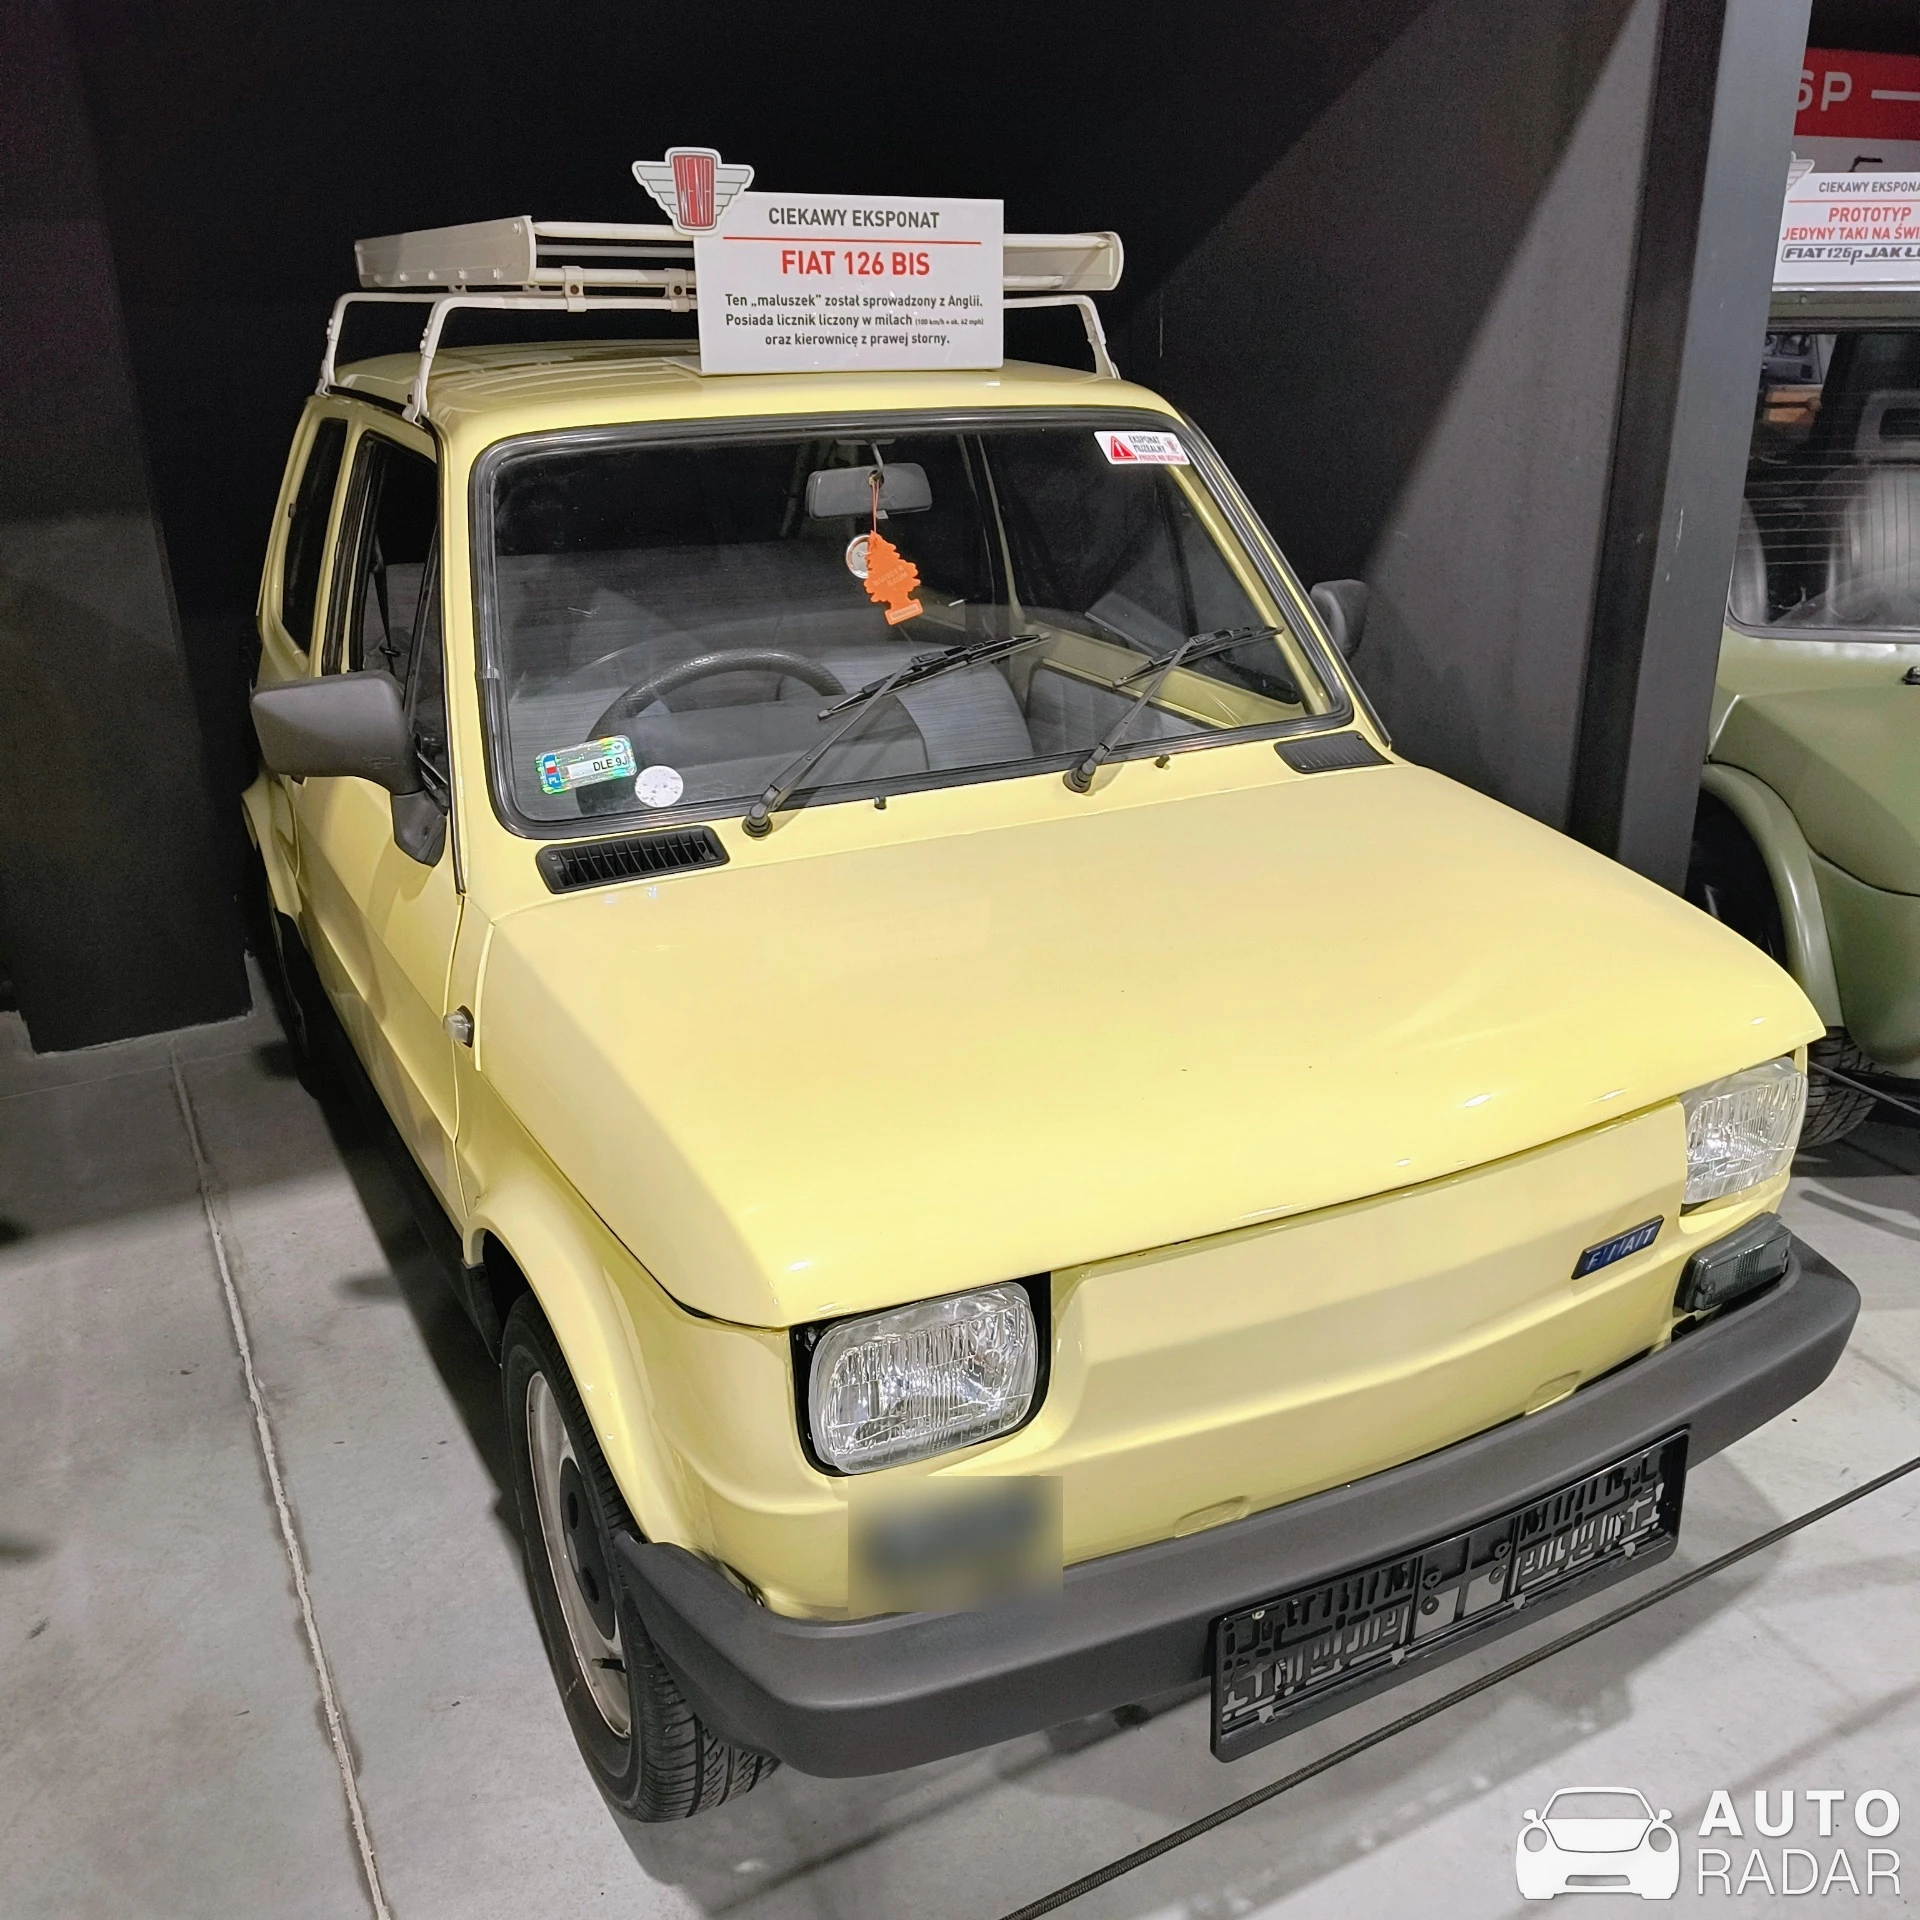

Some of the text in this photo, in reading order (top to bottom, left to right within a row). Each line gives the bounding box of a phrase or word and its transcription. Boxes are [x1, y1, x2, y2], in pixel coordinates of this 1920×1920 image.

[1819, 181, 1869, 193] CIEKAWY
[768, 207, 940, 228] CIEKAWY EKSPONAT
[1828, 207, 1911, 222] PROTOTYP
[1782, 223, 1920, 240] JEDYNY TAKI NA ŚWI
[1785, 247, 1826, 258] FIAT
[1864, 247, 1902, 258] JAK
[782, 250, 930, 276] FIAT 126 BIS
[725, 293, 747, 306] Ten
[824, 295, 859, 306] został
[863, 295, 936, 309] sprowadzony
[939, 298, 945, 306] z
[948, 295, 983, 309] Anglii.
[726, 314, 774, 326] Posiada
[777, 314, 816, 326] licznik
[819, 314, 859, 328] liczony
[862, 317, 871, 326] w
[875, 314, 912, 326] milach
[765, 333, 950, 347] oraz kierownicę z prawej storny.
[593, 758, 613, 771] DLE
[548, 776, 560, 785] PL
[1586, 1226, 1656, 1270] FIAT
